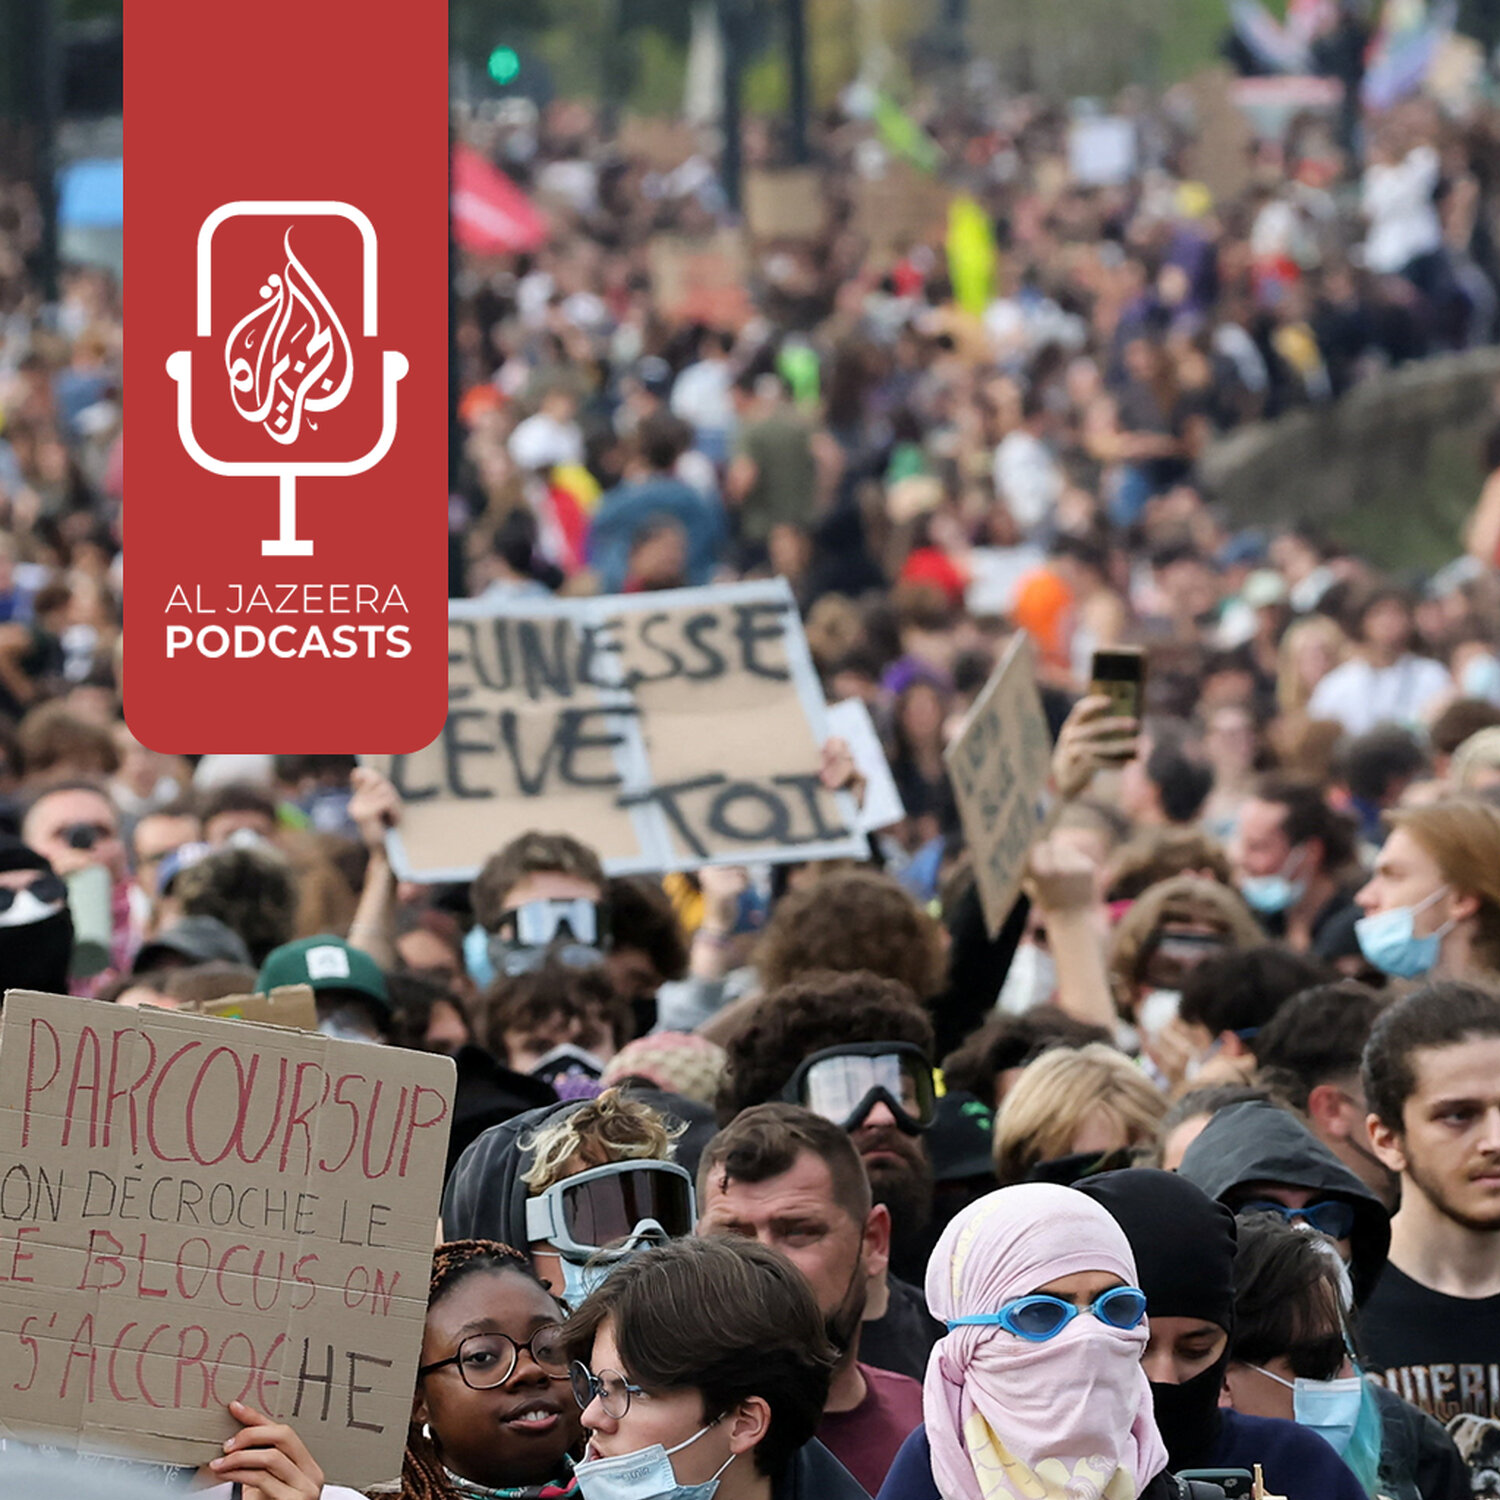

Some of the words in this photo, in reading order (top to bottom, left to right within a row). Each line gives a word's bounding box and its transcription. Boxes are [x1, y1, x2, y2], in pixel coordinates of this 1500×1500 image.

[616, 773, 850, 858] TOI
[21, 1017, 448, 1179] PARCOURSUP
[0, 1163, 64, 1223] ON
[81, 1163, 319, 1236] DÉCROCHE
[339, 1199, 393, 1248] LE
[0, 1226, 41, 1284] E
[77, 1229, 319, 1312] BLOCUS
[343, 1265, 401, 1316] ON
